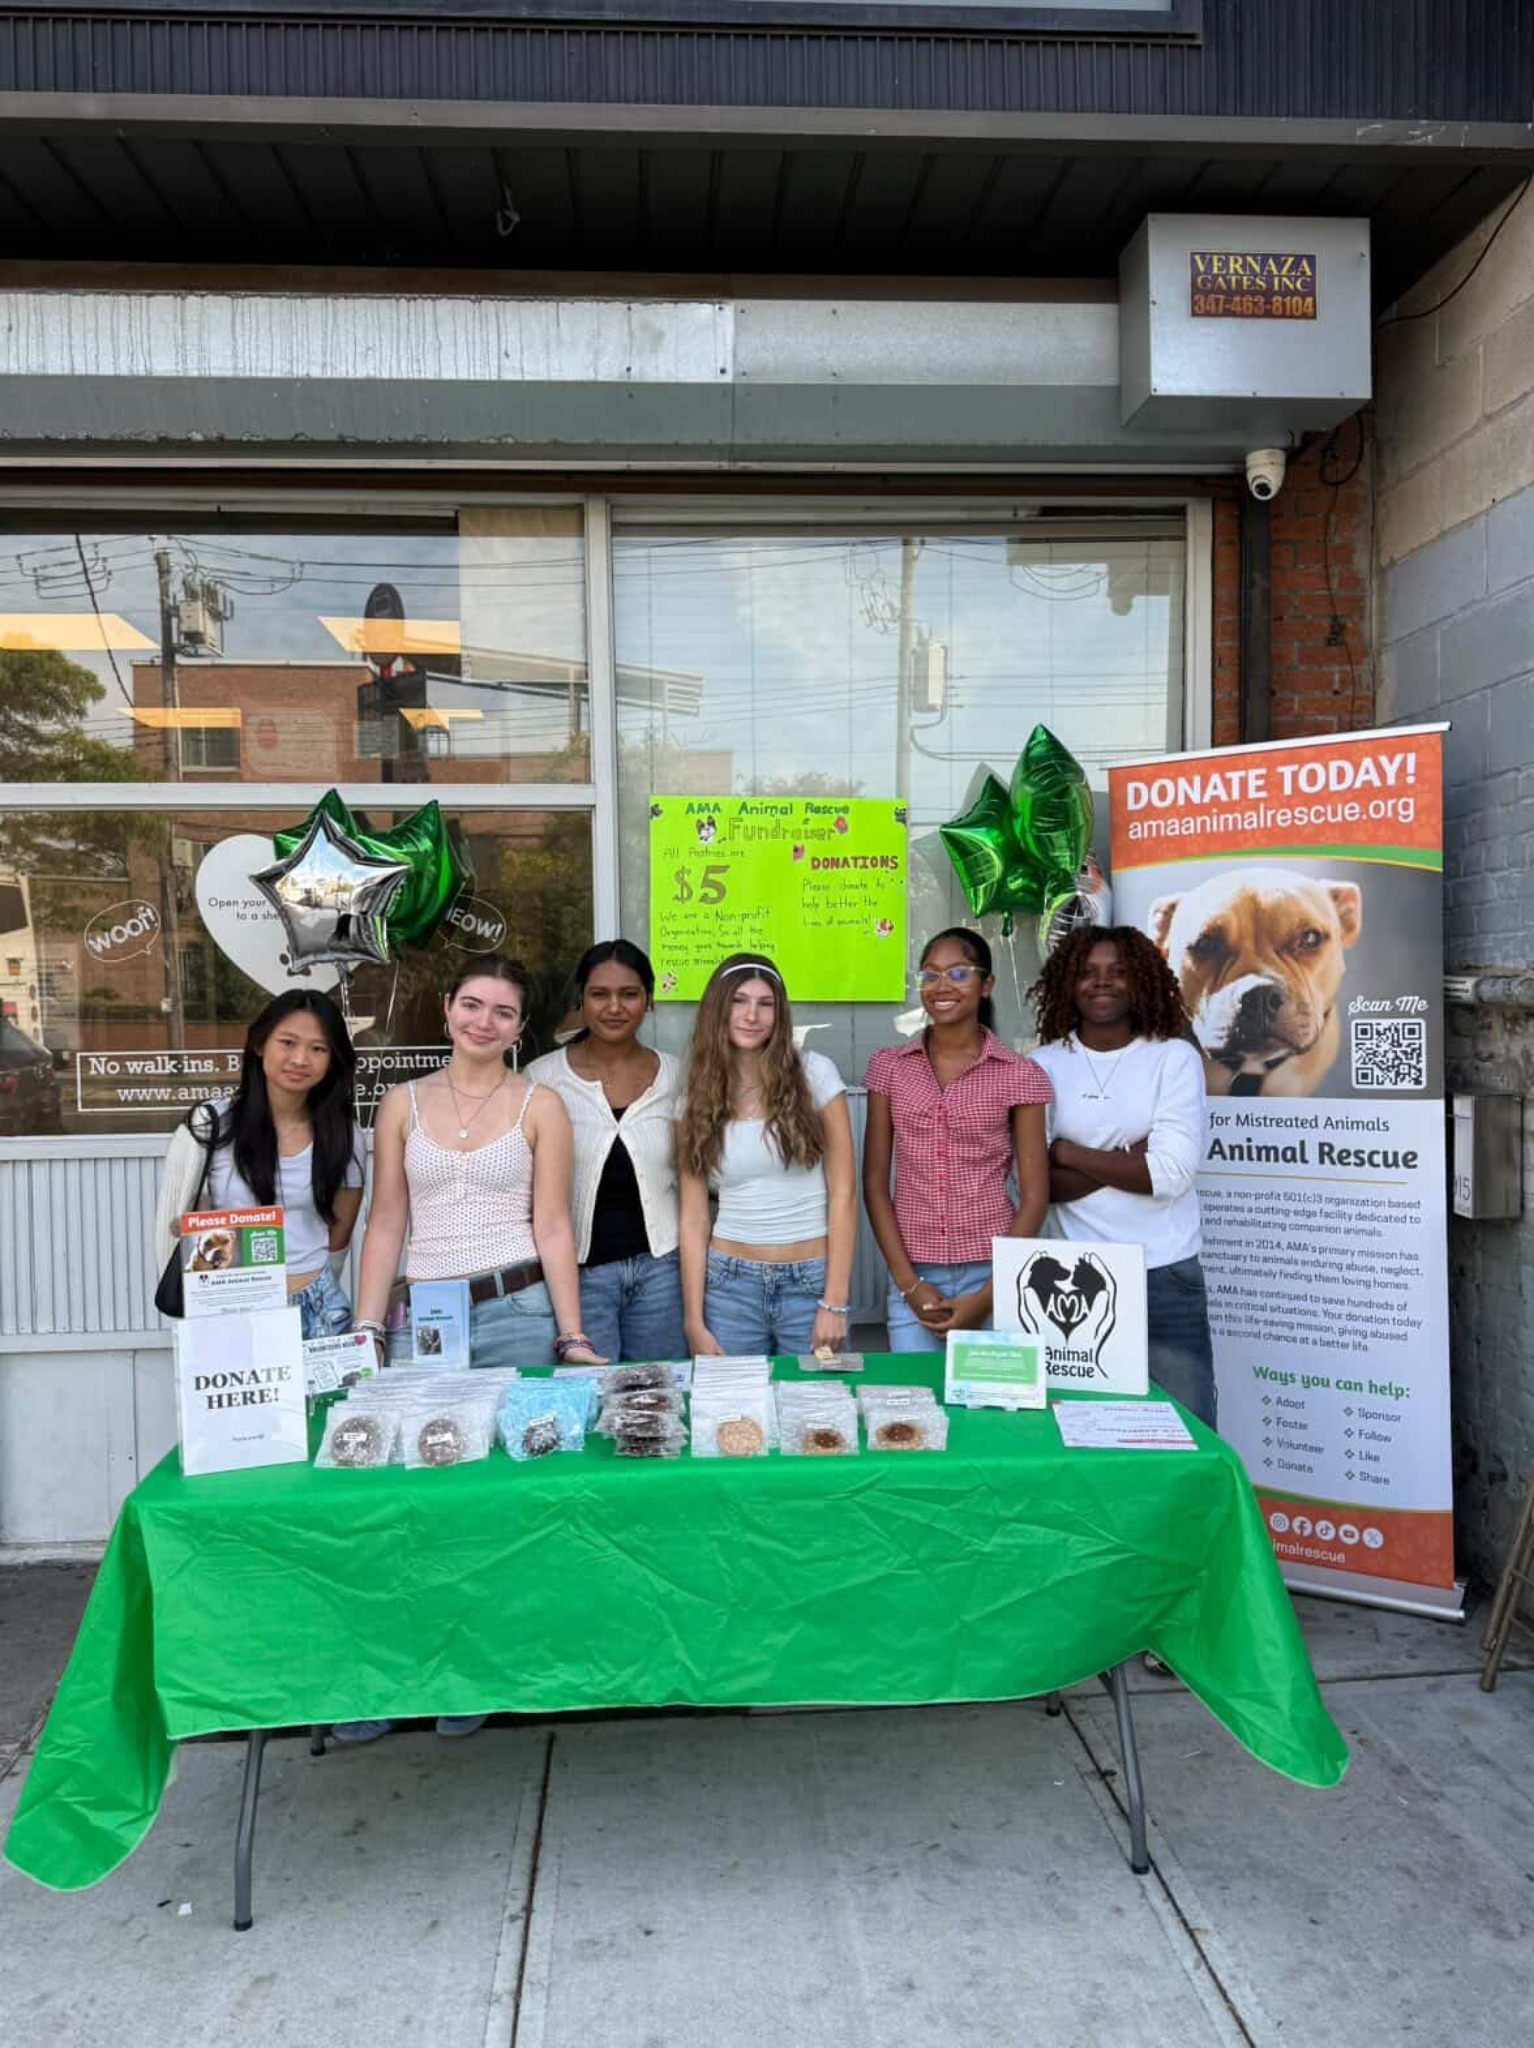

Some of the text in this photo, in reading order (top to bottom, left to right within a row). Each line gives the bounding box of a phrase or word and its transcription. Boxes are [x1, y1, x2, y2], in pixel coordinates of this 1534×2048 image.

[1193, 255, 1313, 276] VERNAZA
[1197, 275, 1311, 292] GATES INC
[1126, 752, 1418, 811] DONATE TODAY!
[685, 802, 850, 817] AMA Animal Rescue
[1128, 796, 1416, 840] amaanimalrescue.org
[811, 855, 899, 870] DONATIONS
[672, 864, 731, 905] $5
[208, 897, 267, 910] Open your
[236, 912, 247, 920] to
[1348, 995, 1429, 1015] Scan Me
[88, 1051, 451, 1075] No walk-ins. B ppointme
[1209, 1112, 1389, 1132] for Mistreated Animals
[1207, 1138, 1418, 1169] Animal Rescue
[1387, 1197, 1421, 1209] based
[188, 1210, 276, 1228] Please Donate!
[1319, 1209, 1353, 1222] facility
[1355, 1212, 1407, 1224] dedicated
[1409, 1215, 1422, 1224] to
[1217, 1285, 1239, 1295] AMA
[1341, 1275, 1372, 1290] loving
[1345, 1312, 1389, 1325] donation
[1392, 1316, 1423, 1330] today
[194, 1366, 292, 1391] DONATE
[1252, 1366, 1411, 1401] Ways you can help:
[207, 1388, 279, 1410] HERE!
[1276, 1396, 1305, 1410] Adopt
[1276, 1416, 1309, 1431] Foster
[1358, 1407, 1402, 1424] Sponsor
[1358, 1429, 1393, 1444] Follow
[1276, 1438, 1325, 1454] Volunteer
[1359, 1450, 1381, 1463] Like
[1277, 1459, 1315, 1474] Donate
[1359, 1471, 1390, 1486] Share
